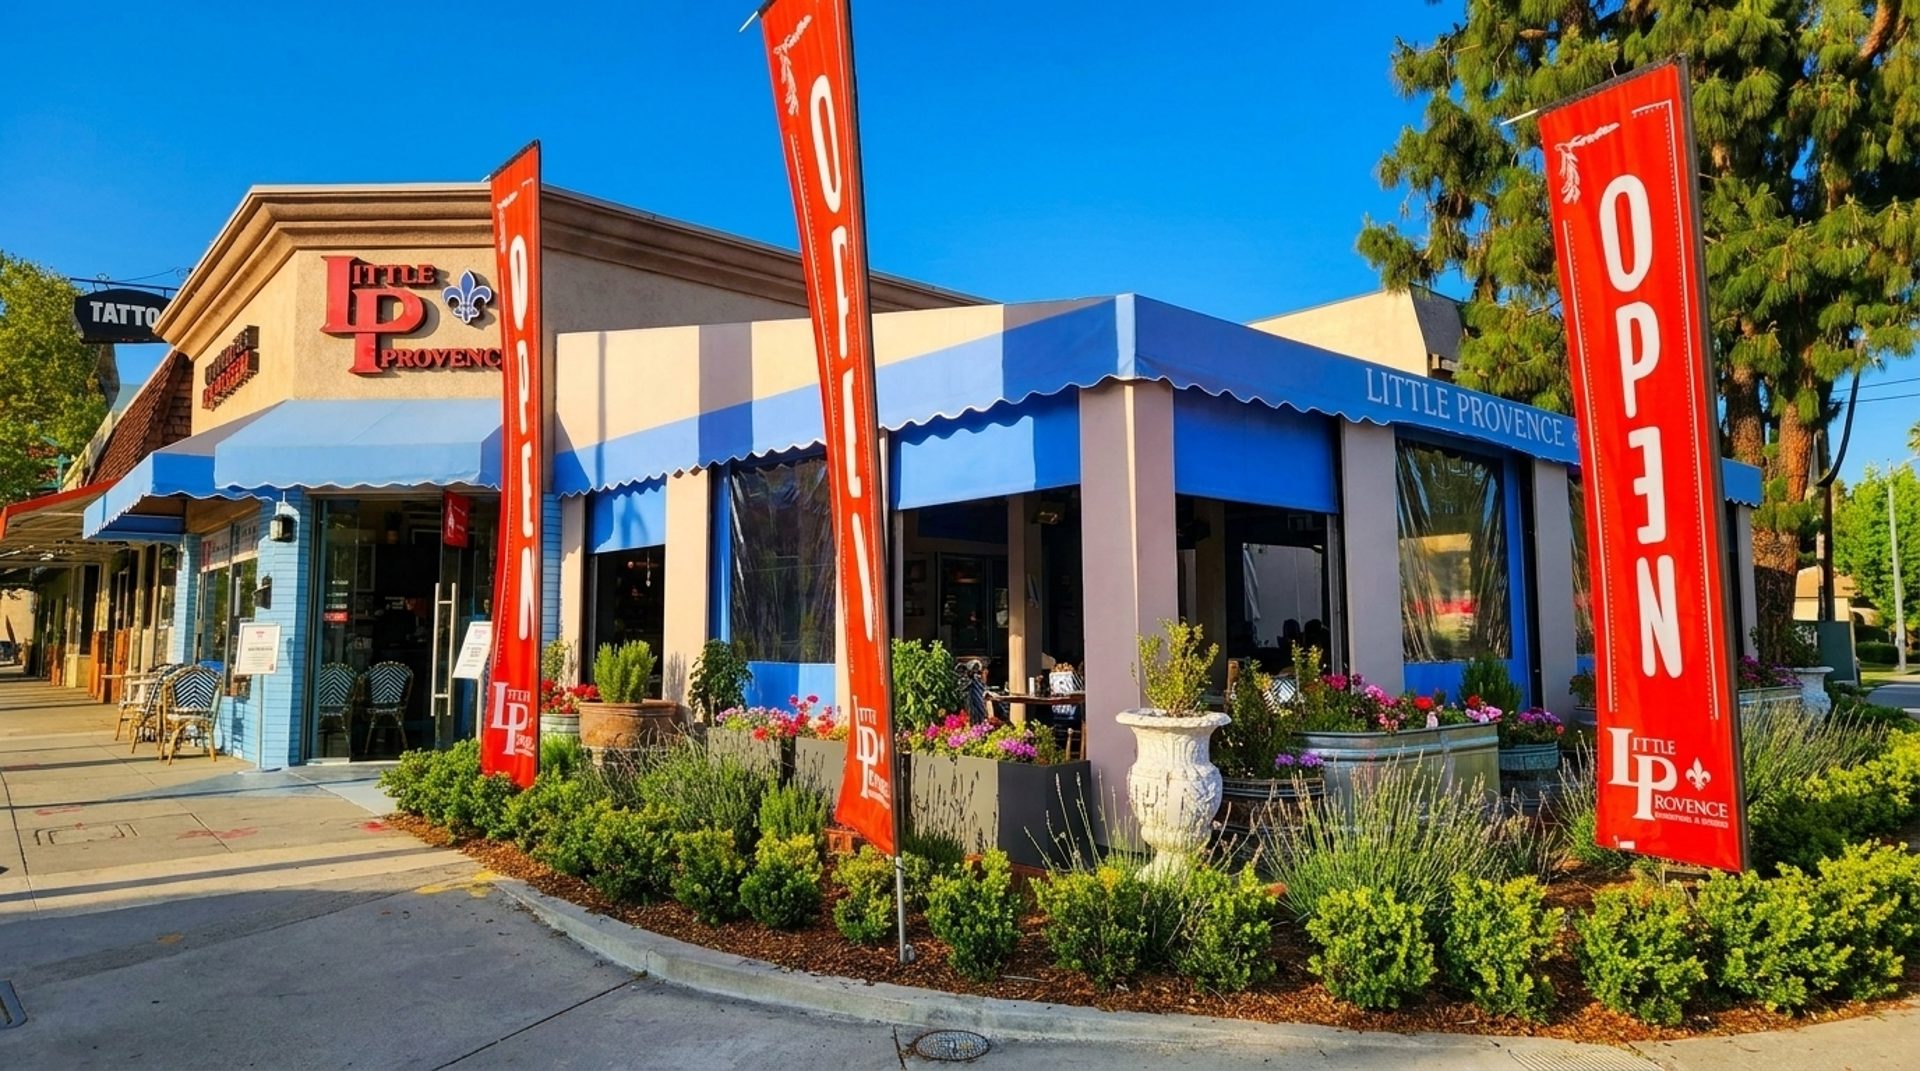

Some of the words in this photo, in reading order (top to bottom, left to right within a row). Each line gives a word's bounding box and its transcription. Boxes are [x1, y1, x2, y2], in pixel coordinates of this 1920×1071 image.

[89, 300, 162, 328] TATTO
[380, 347, 502, 369] PROVENC
[1365, 367, 1450, 420] LITTLE
[1456, 392, 1565, 447] PROVENCE
[1599, 173, 1683, 679] OPEN
[1606, 726, 1677, 788] LITTLE
